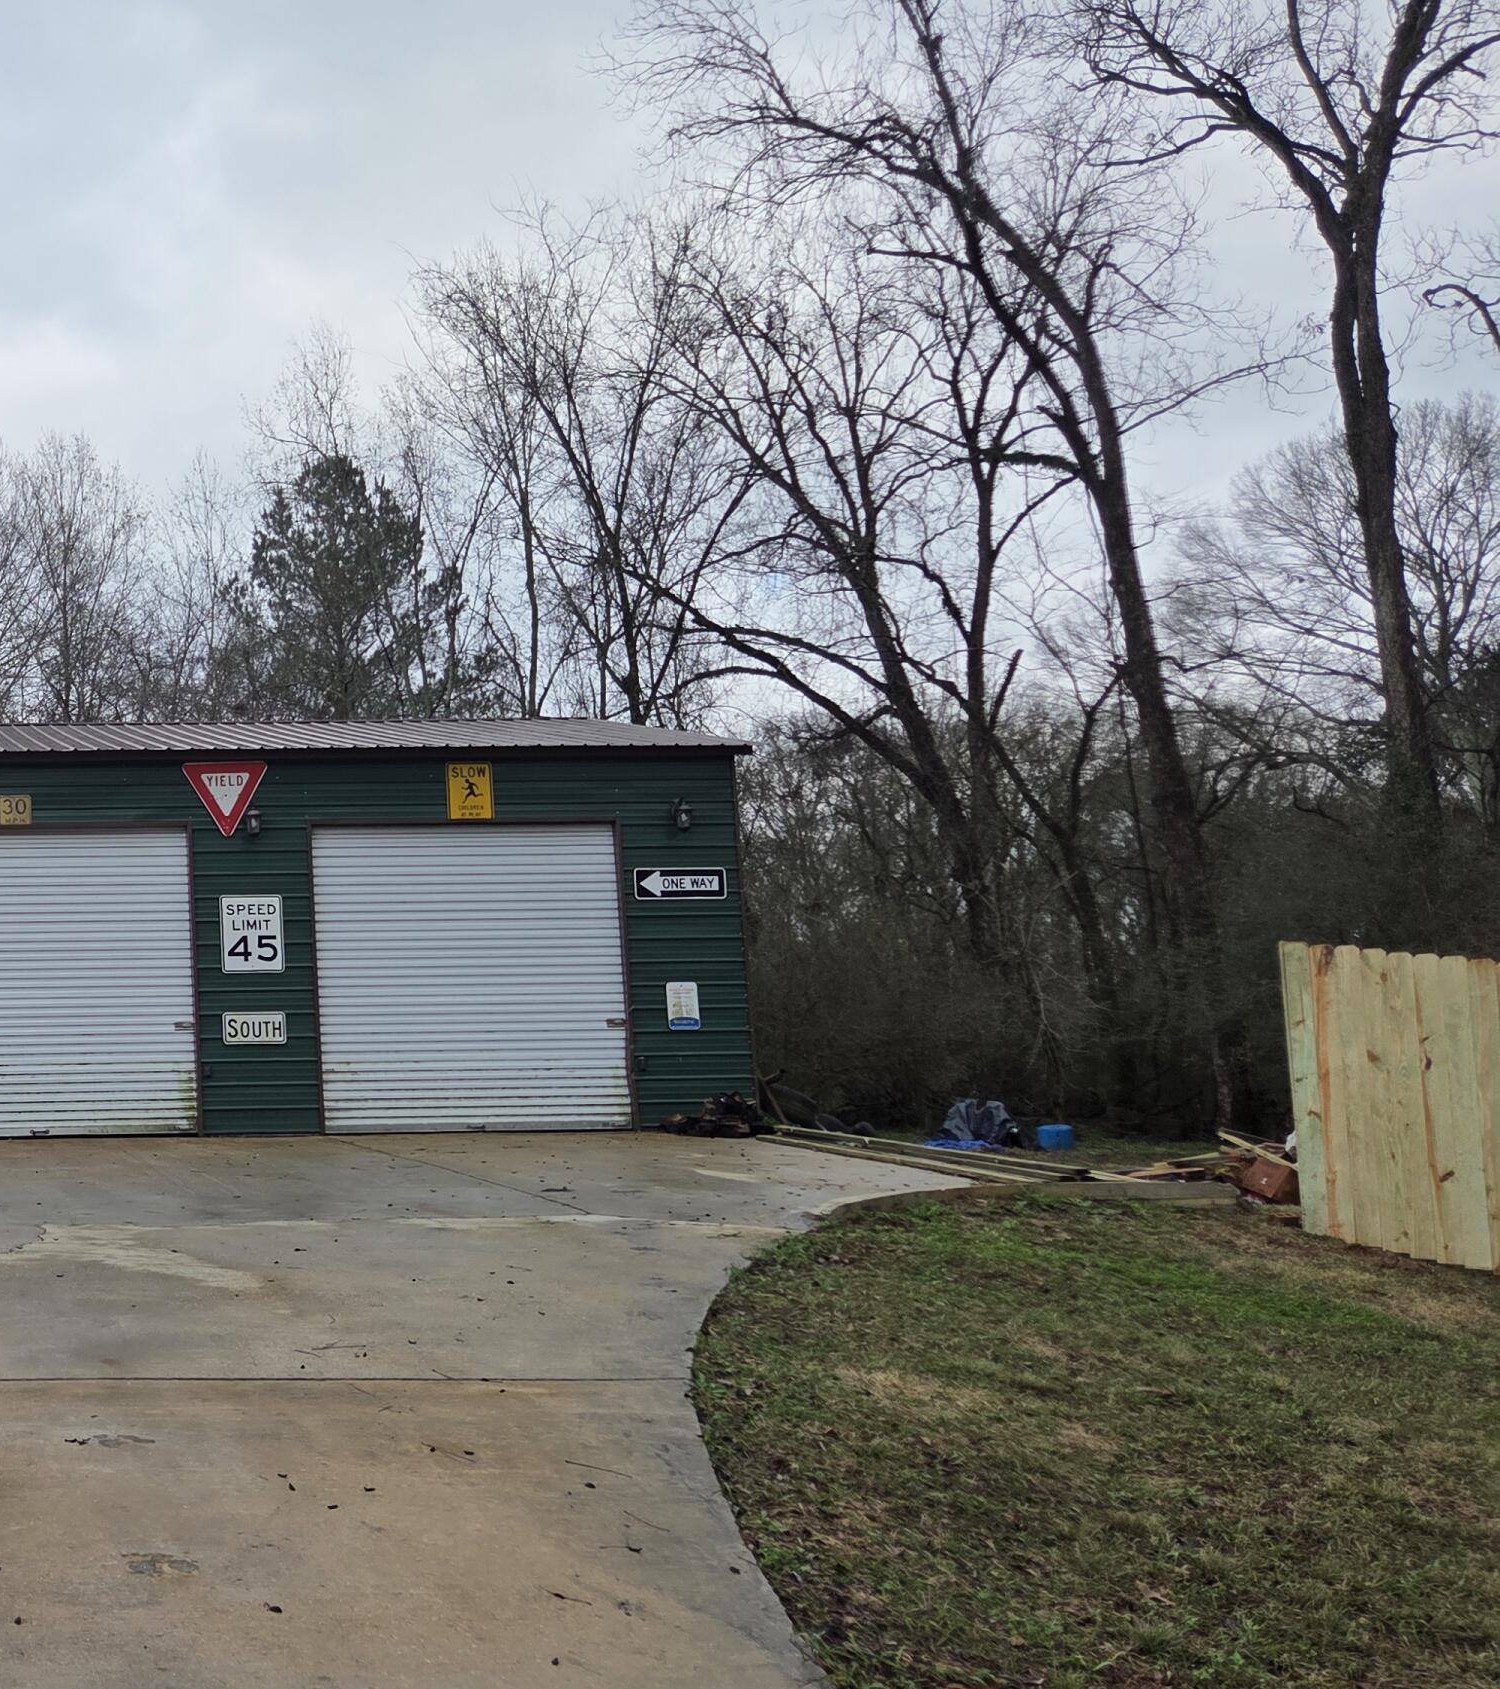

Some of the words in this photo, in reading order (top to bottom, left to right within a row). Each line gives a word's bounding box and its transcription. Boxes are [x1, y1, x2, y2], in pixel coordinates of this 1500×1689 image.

[451, 766, 486, 778] SLOW
[206, 775, 244, 787] YIELD
[2, 798, 27, 815] 30
[662, 878, 687, 889] ONE
[690, 877, 715, 889] WAY
[226, 903, 277, 916] SPEED
[232, 919, 272, 931] LIMIT
[227, 935, 279, 962] 45
[227, 1018, 282, 1038] SOUTH
